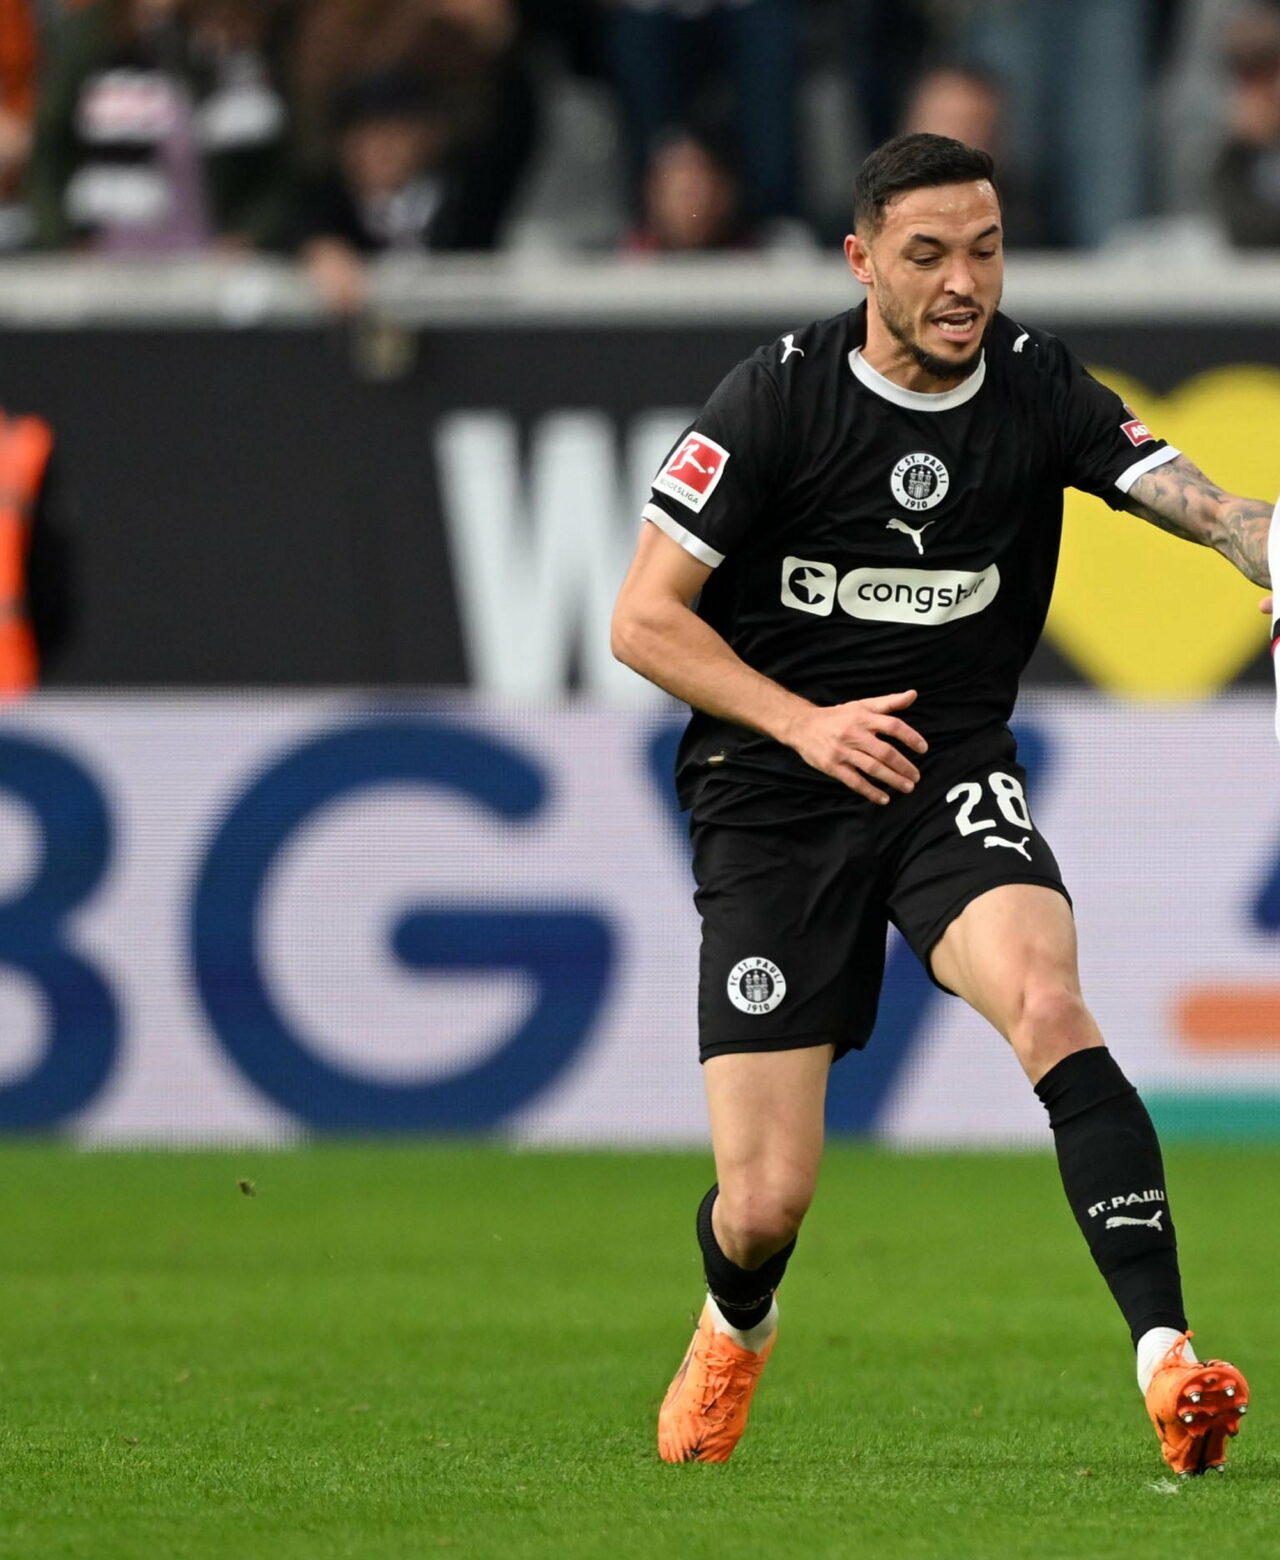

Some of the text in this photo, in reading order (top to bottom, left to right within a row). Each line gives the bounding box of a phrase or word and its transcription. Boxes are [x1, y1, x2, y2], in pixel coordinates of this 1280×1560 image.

[922, 455, 948, 484] PAULI
[904, 498, 928, 510] 1910
[946, 772, 1033, 837] 28
[756, 959, 784, 984] PAULI
[746, 1003, 771, 1013] 1910
